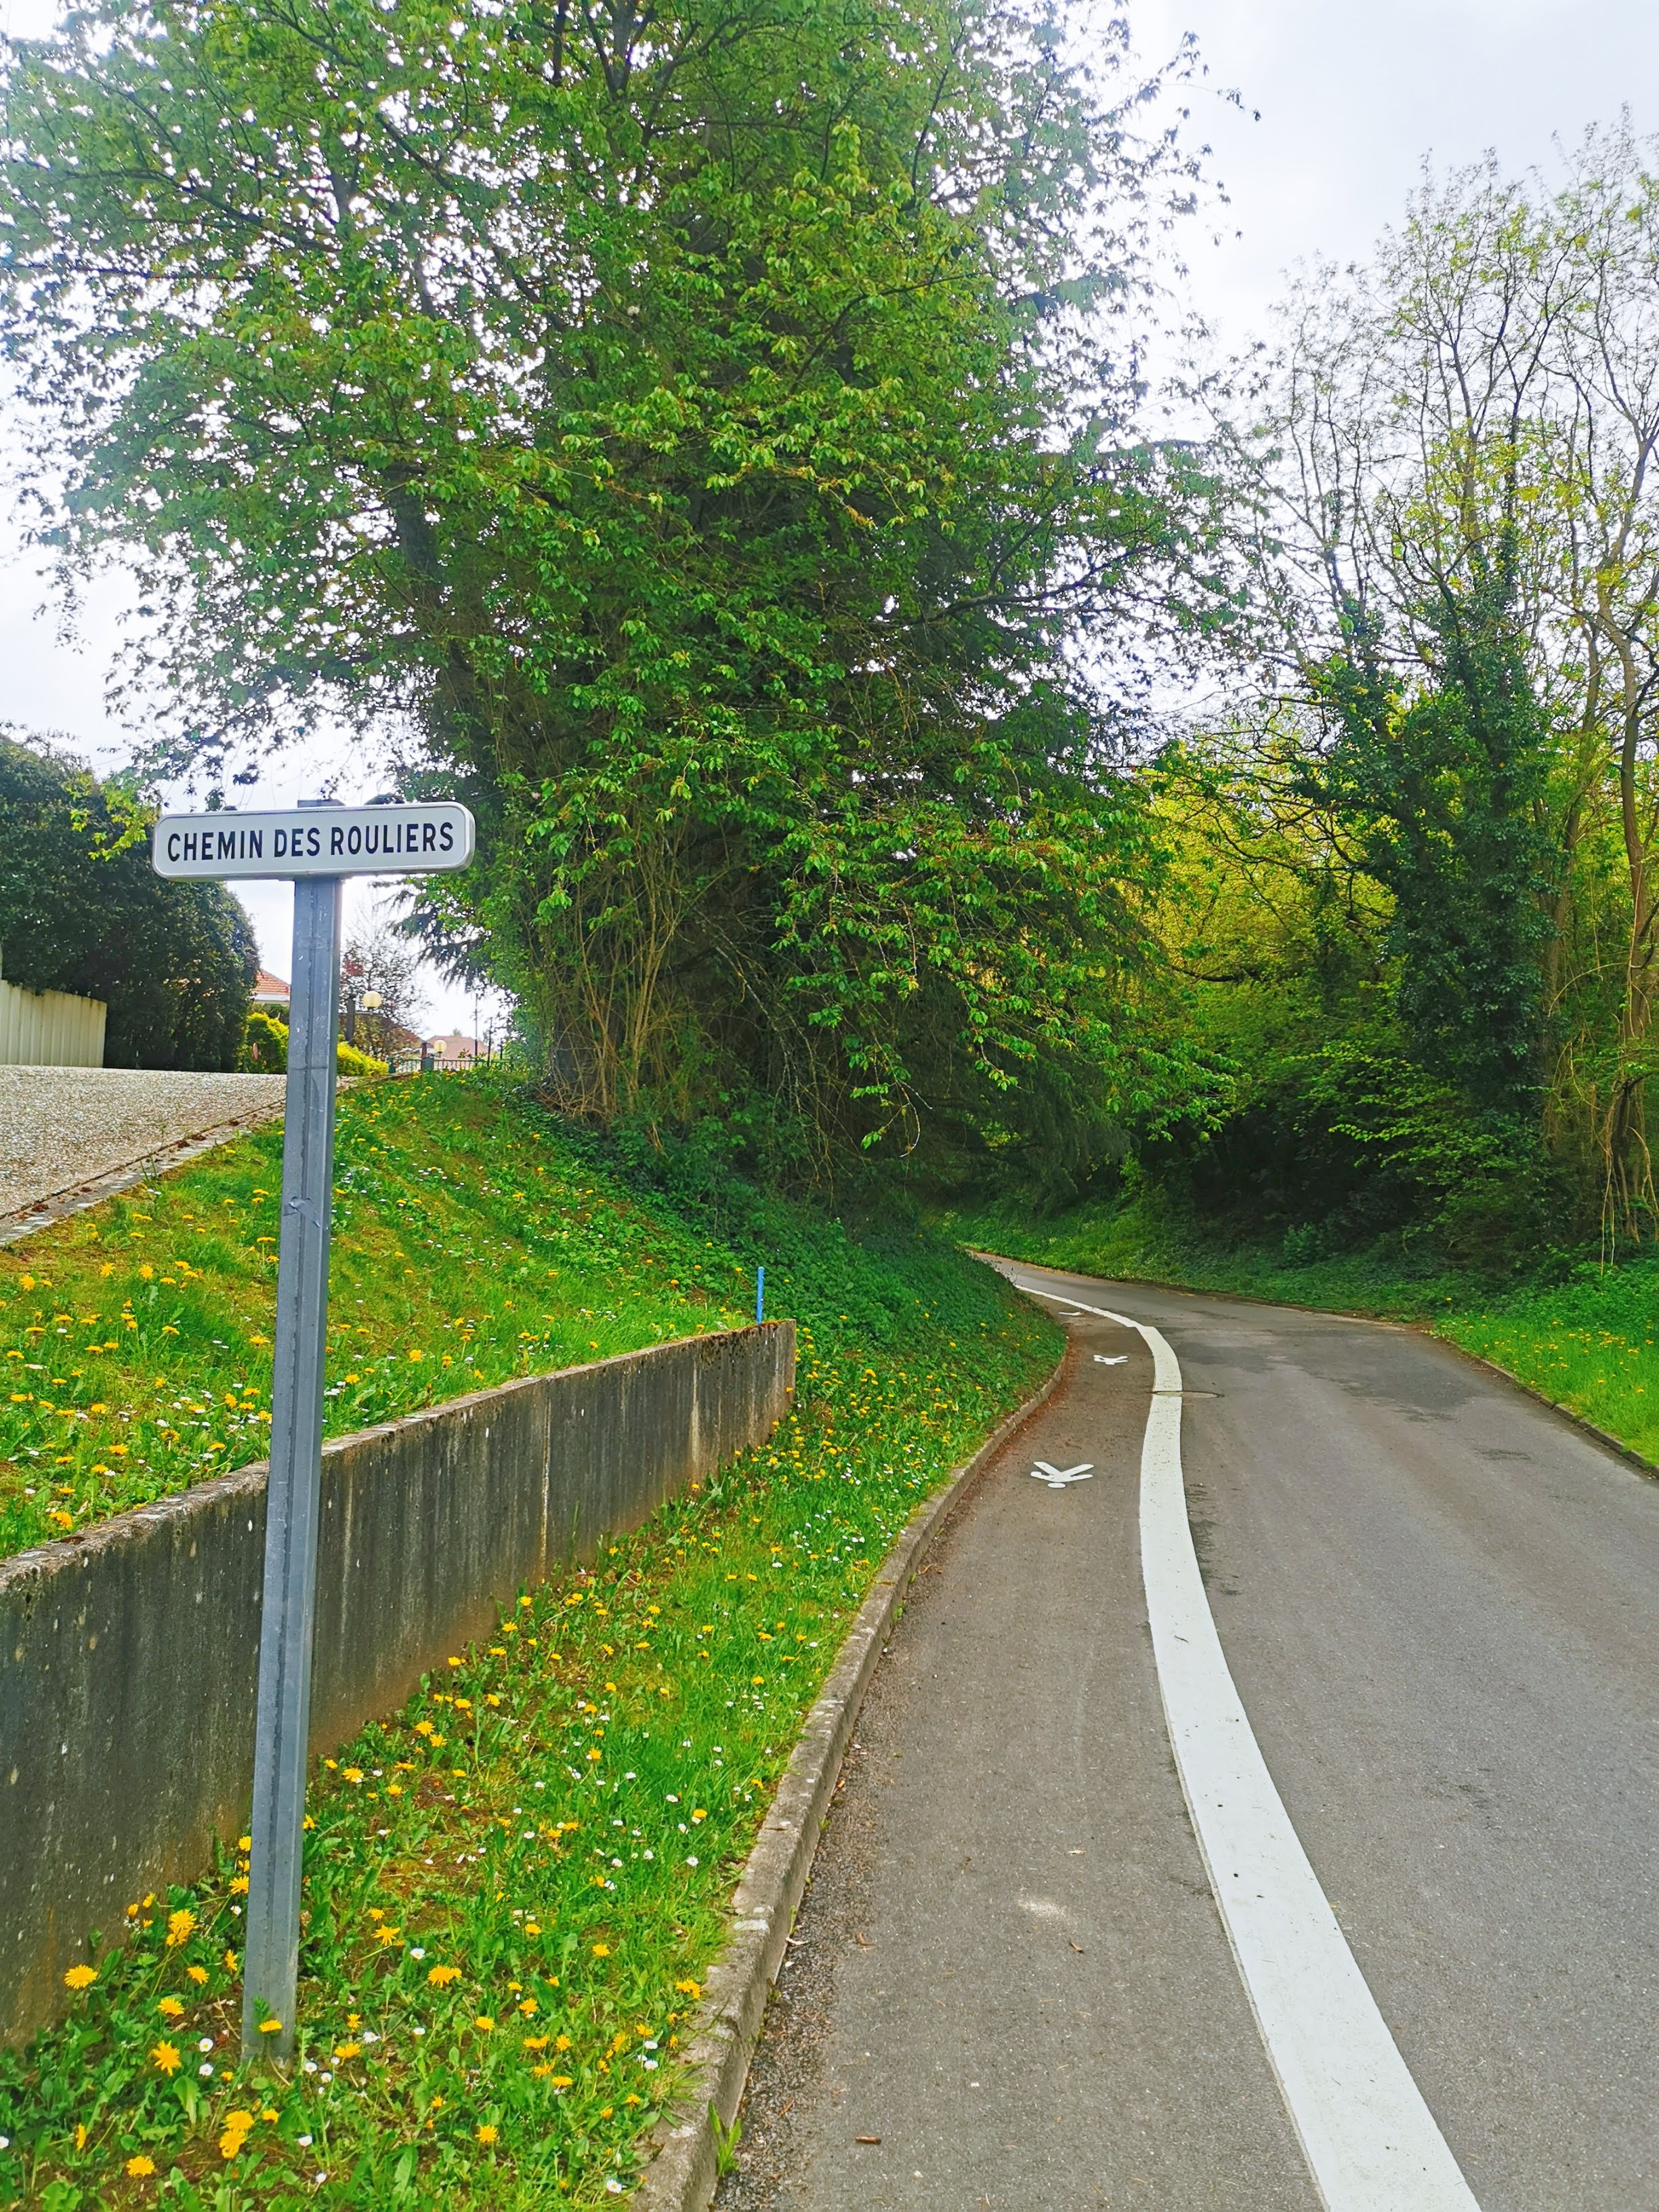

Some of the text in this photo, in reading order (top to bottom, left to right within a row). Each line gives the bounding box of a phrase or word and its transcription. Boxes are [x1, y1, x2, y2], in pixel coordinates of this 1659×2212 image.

[167, 822, 453, 862] CHEMIN DES ROULIERS
